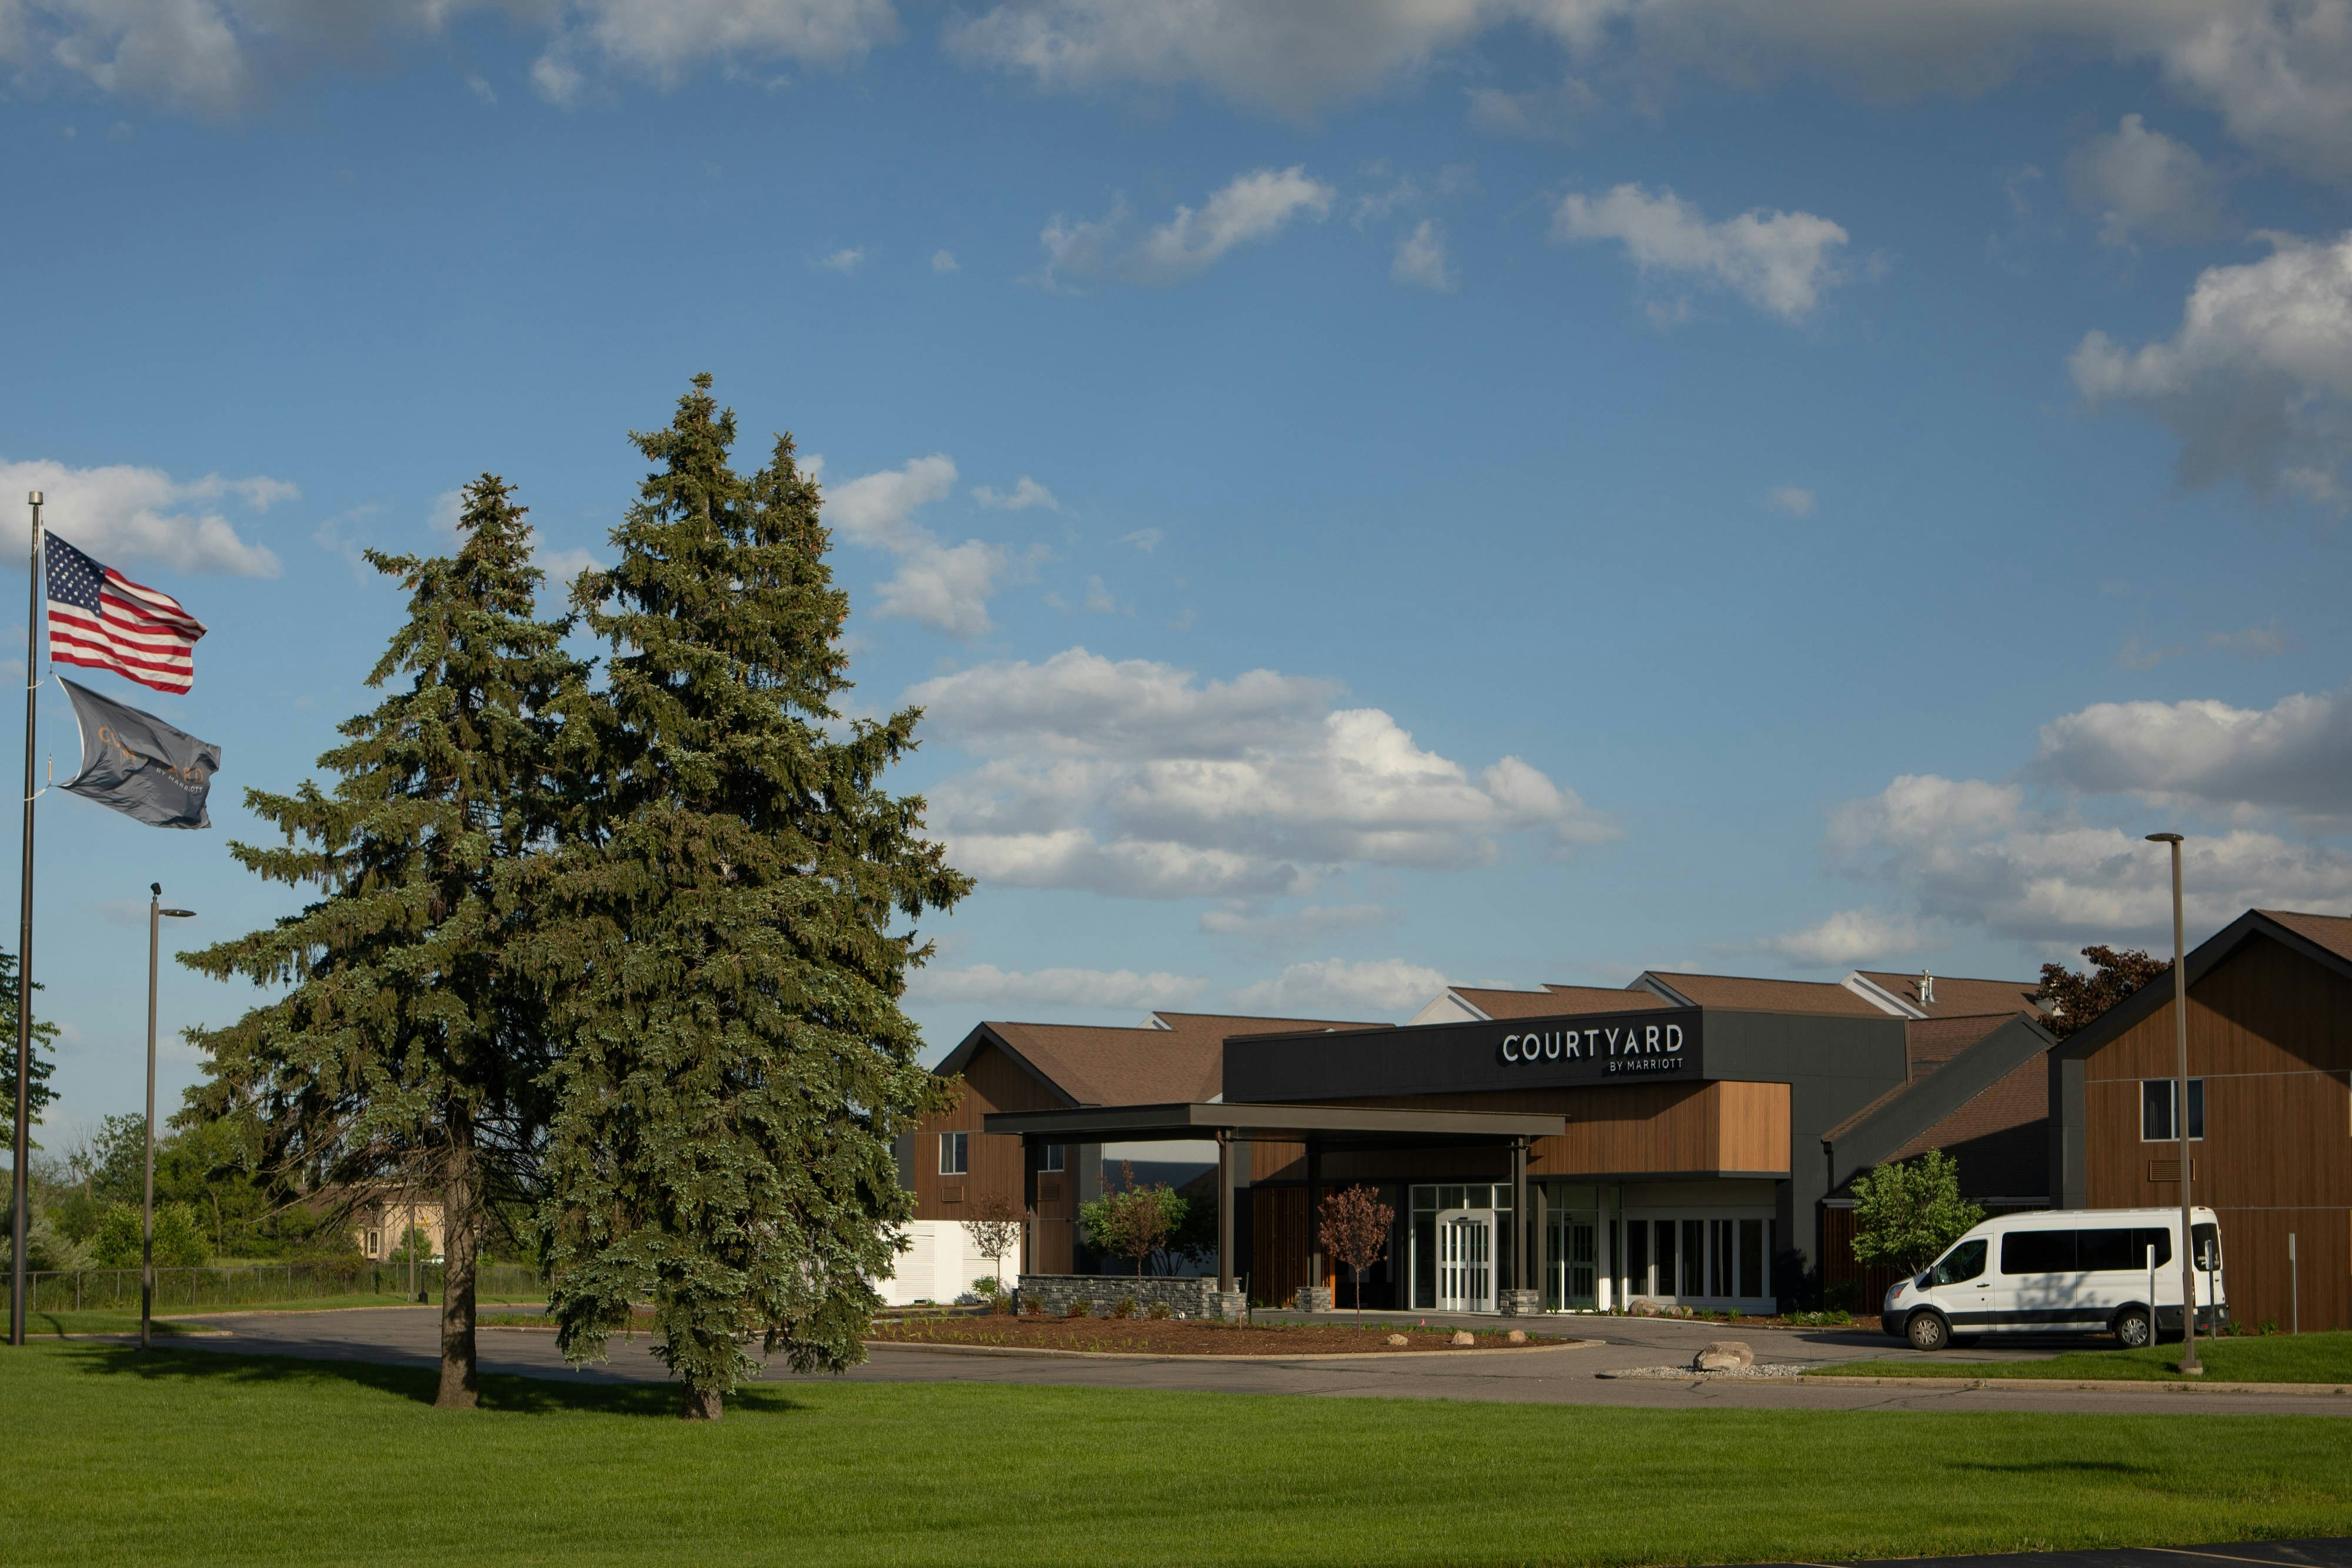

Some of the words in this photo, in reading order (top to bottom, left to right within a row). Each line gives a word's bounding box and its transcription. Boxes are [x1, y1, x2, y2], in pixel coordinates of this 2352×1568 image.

[156, 767, 166, 775] BY
[168, 775, 203, 793] MARRIOTT
[1503, 1025, 1683, 1061] COURTYARD
[1610, 1062, 1623, 1071] BY
[1627, 1058, 1683, 1070] MARRIOTT
